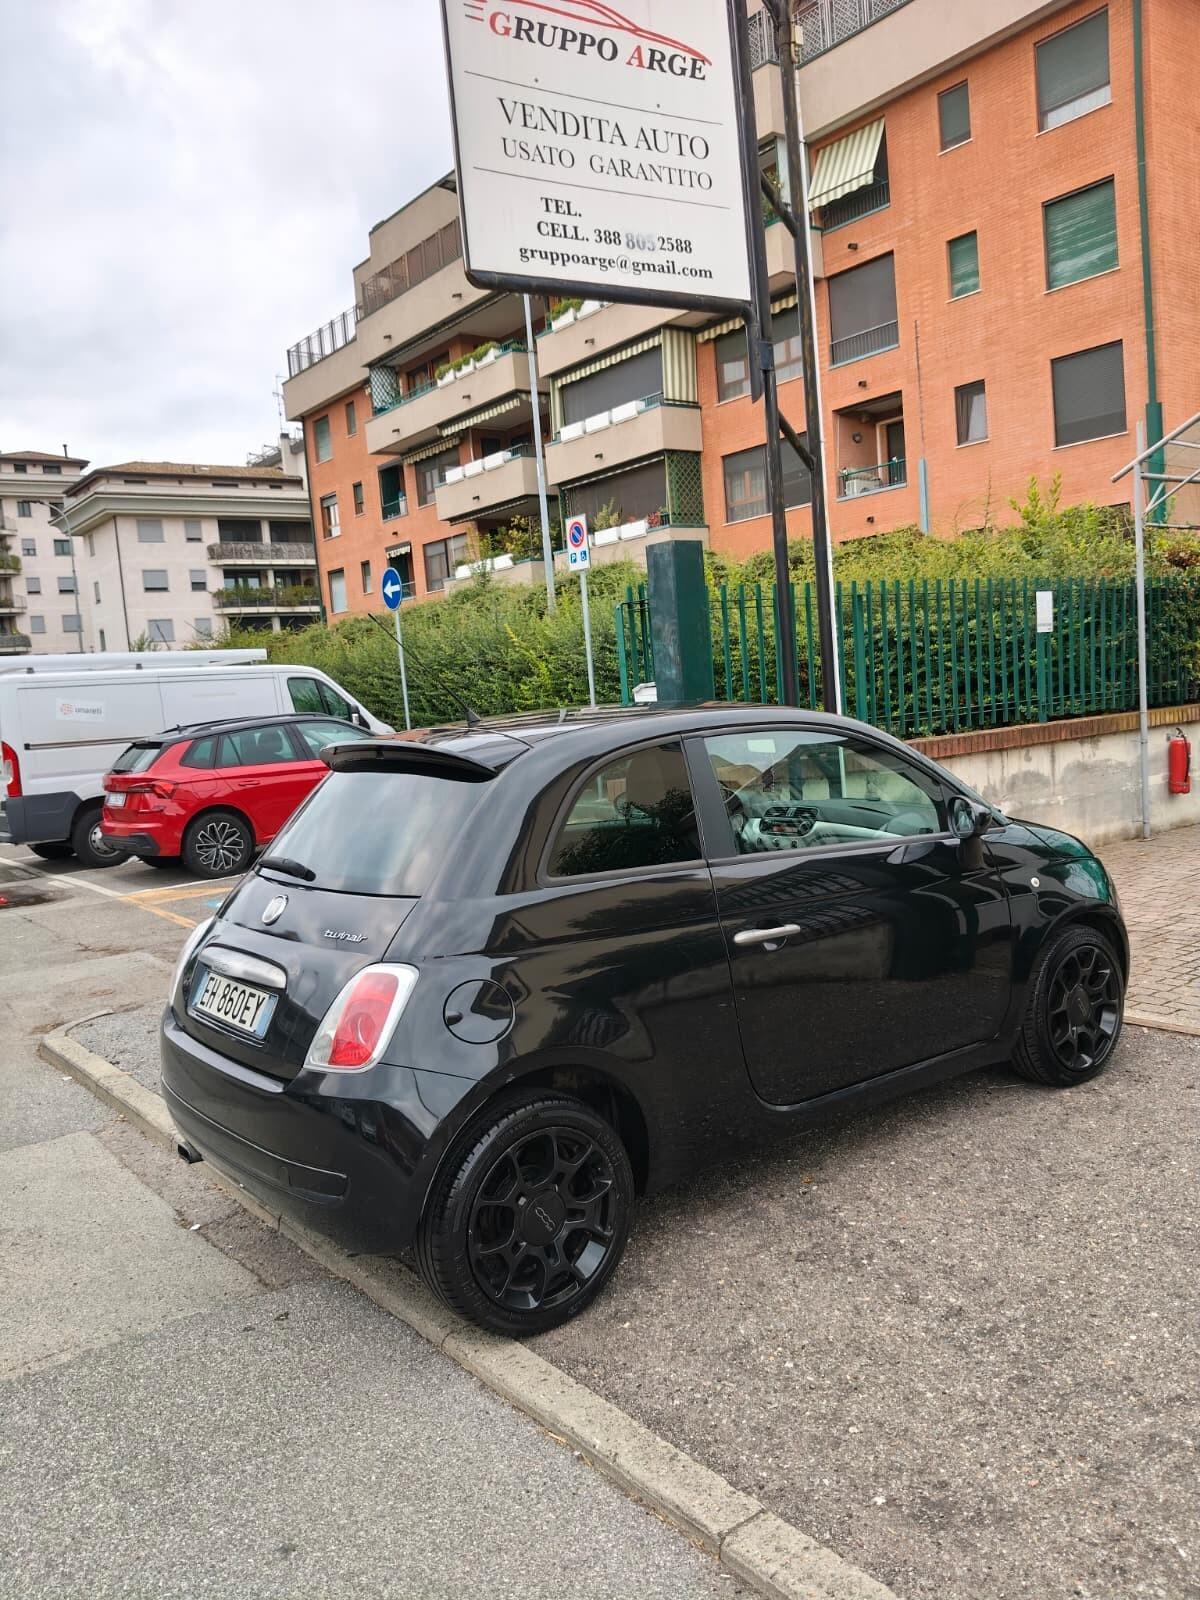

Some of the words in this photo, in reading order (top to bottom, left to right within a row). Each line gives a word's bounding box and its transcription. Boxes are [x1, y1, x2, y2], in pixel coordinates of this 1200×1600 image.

[489, 11, 618, 62] GRUPPO
[626, 44, 707, 80] ARGE
[497, 97, 628, 147] VENDITA
[635, 127, 710, 160] AUTO
[501, 137, 576, 169] USATO
[589, 154, 713, 190] GARANTITO
[540, 197, 582, 217] TEL.
[537, 220, 590, 242] CELL.
[594, 228, 622, 246] 388
[657, 236, 693, 255] 2588
[519, 247, 713, 279] gruppoarge@gmail.com
[217, 983, 266, 1027] 860EY
